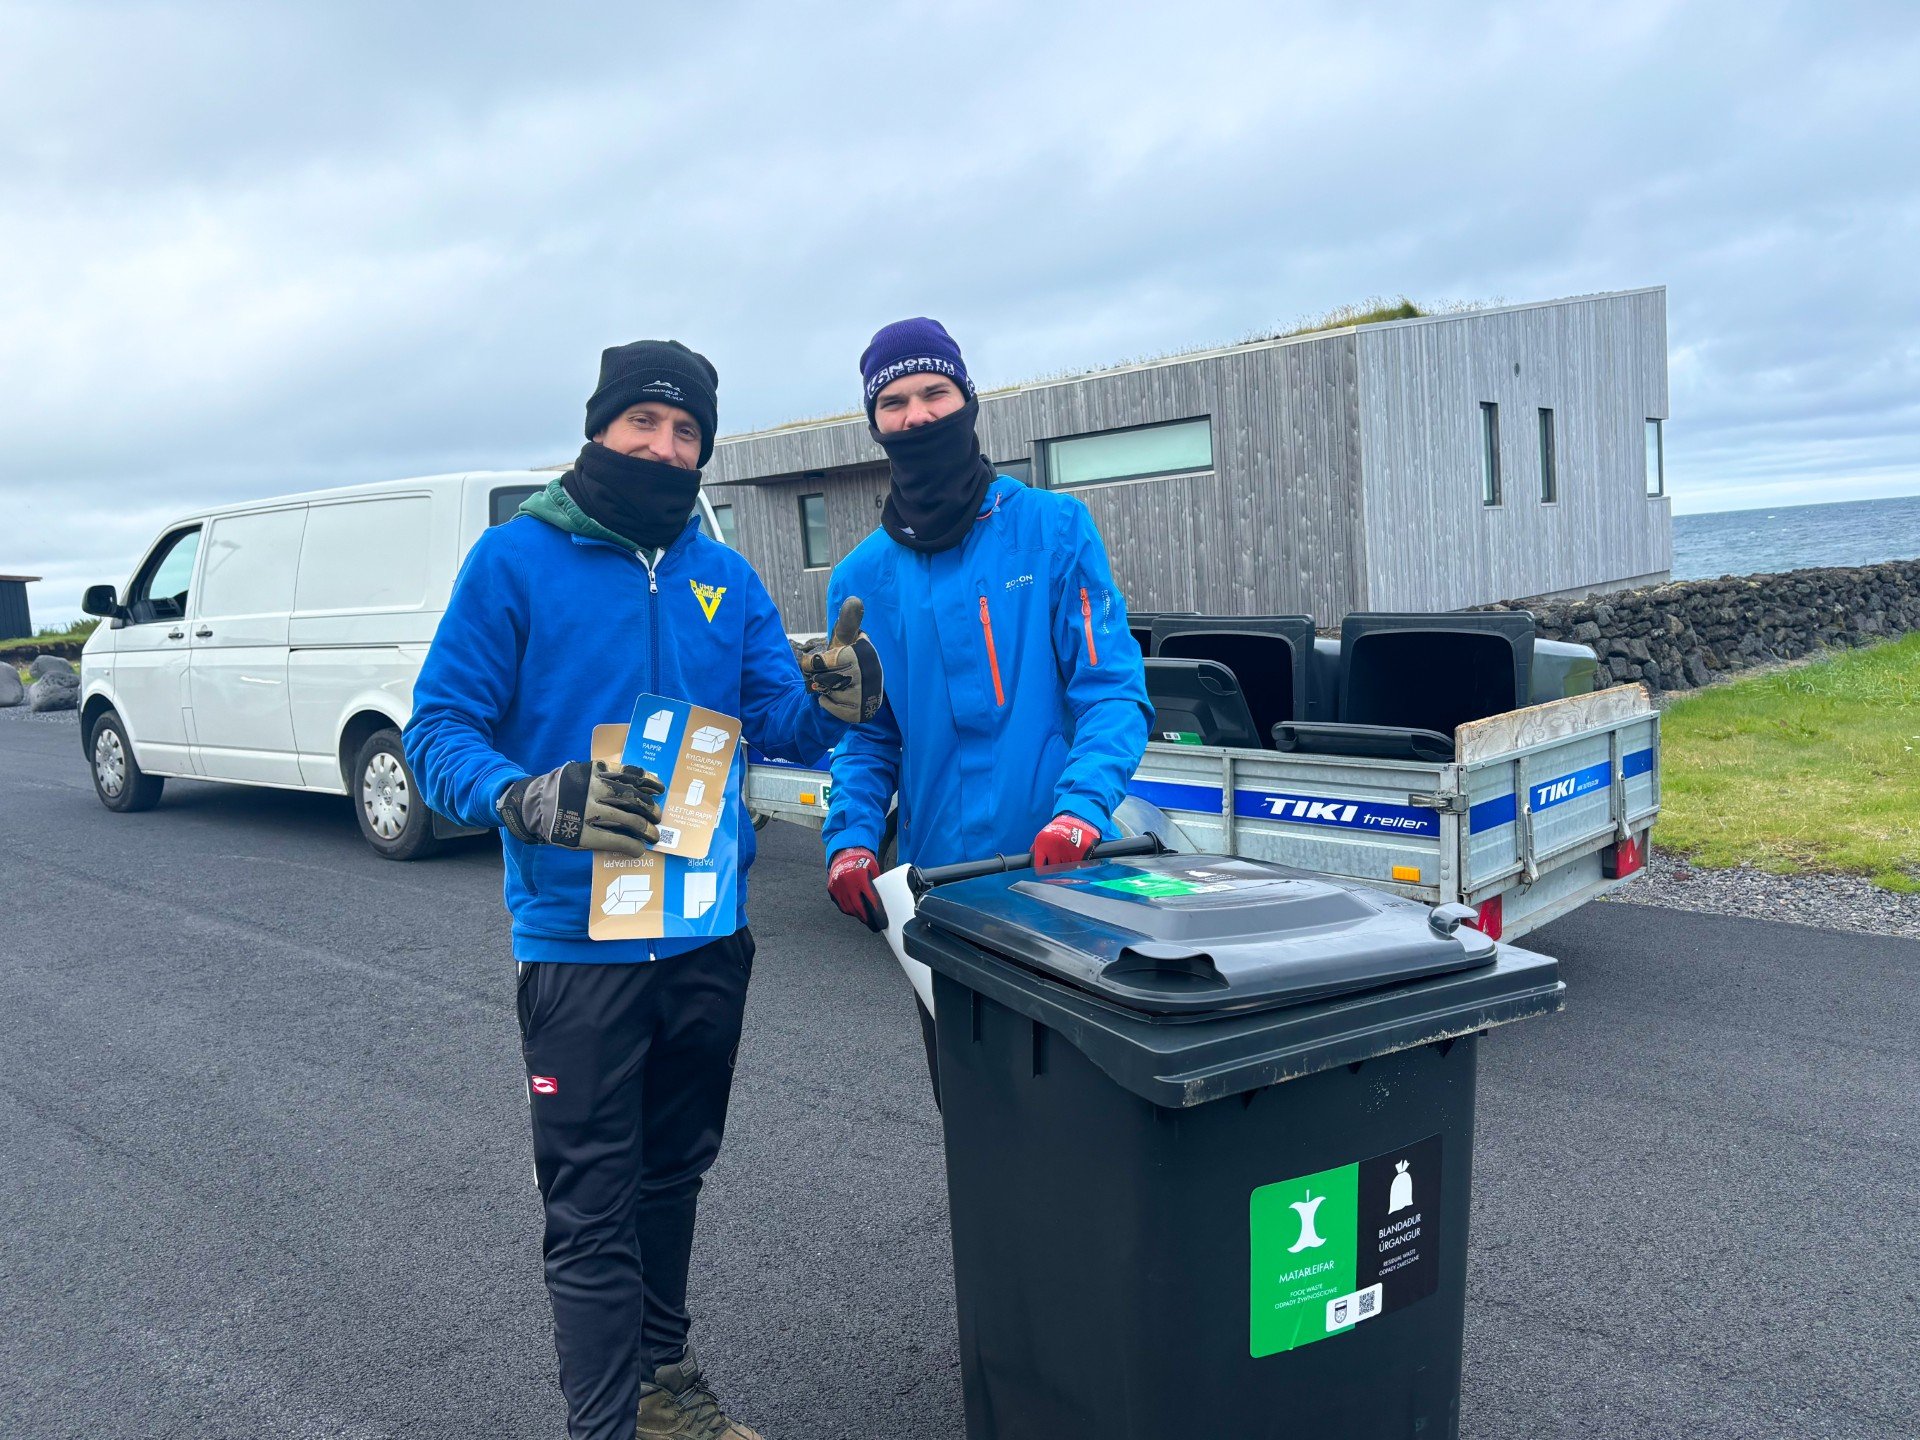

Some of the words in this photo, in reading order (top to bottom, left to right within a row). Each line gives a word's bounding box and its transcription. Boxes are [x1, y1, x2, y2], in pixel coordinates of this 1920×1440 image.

[1537, 777, 1576, 805] TIKI
[1265, 797, 1358, 822] TIKI
[1363, 813, 1427, 830] treiler
[1378, 1213, 1421, 1239] BLANDAÐUR
[1378, 1228, 1421, 1253] ÚRGANGUR
[1278, 1260, 1335, 1284] MATARLEIFAR
